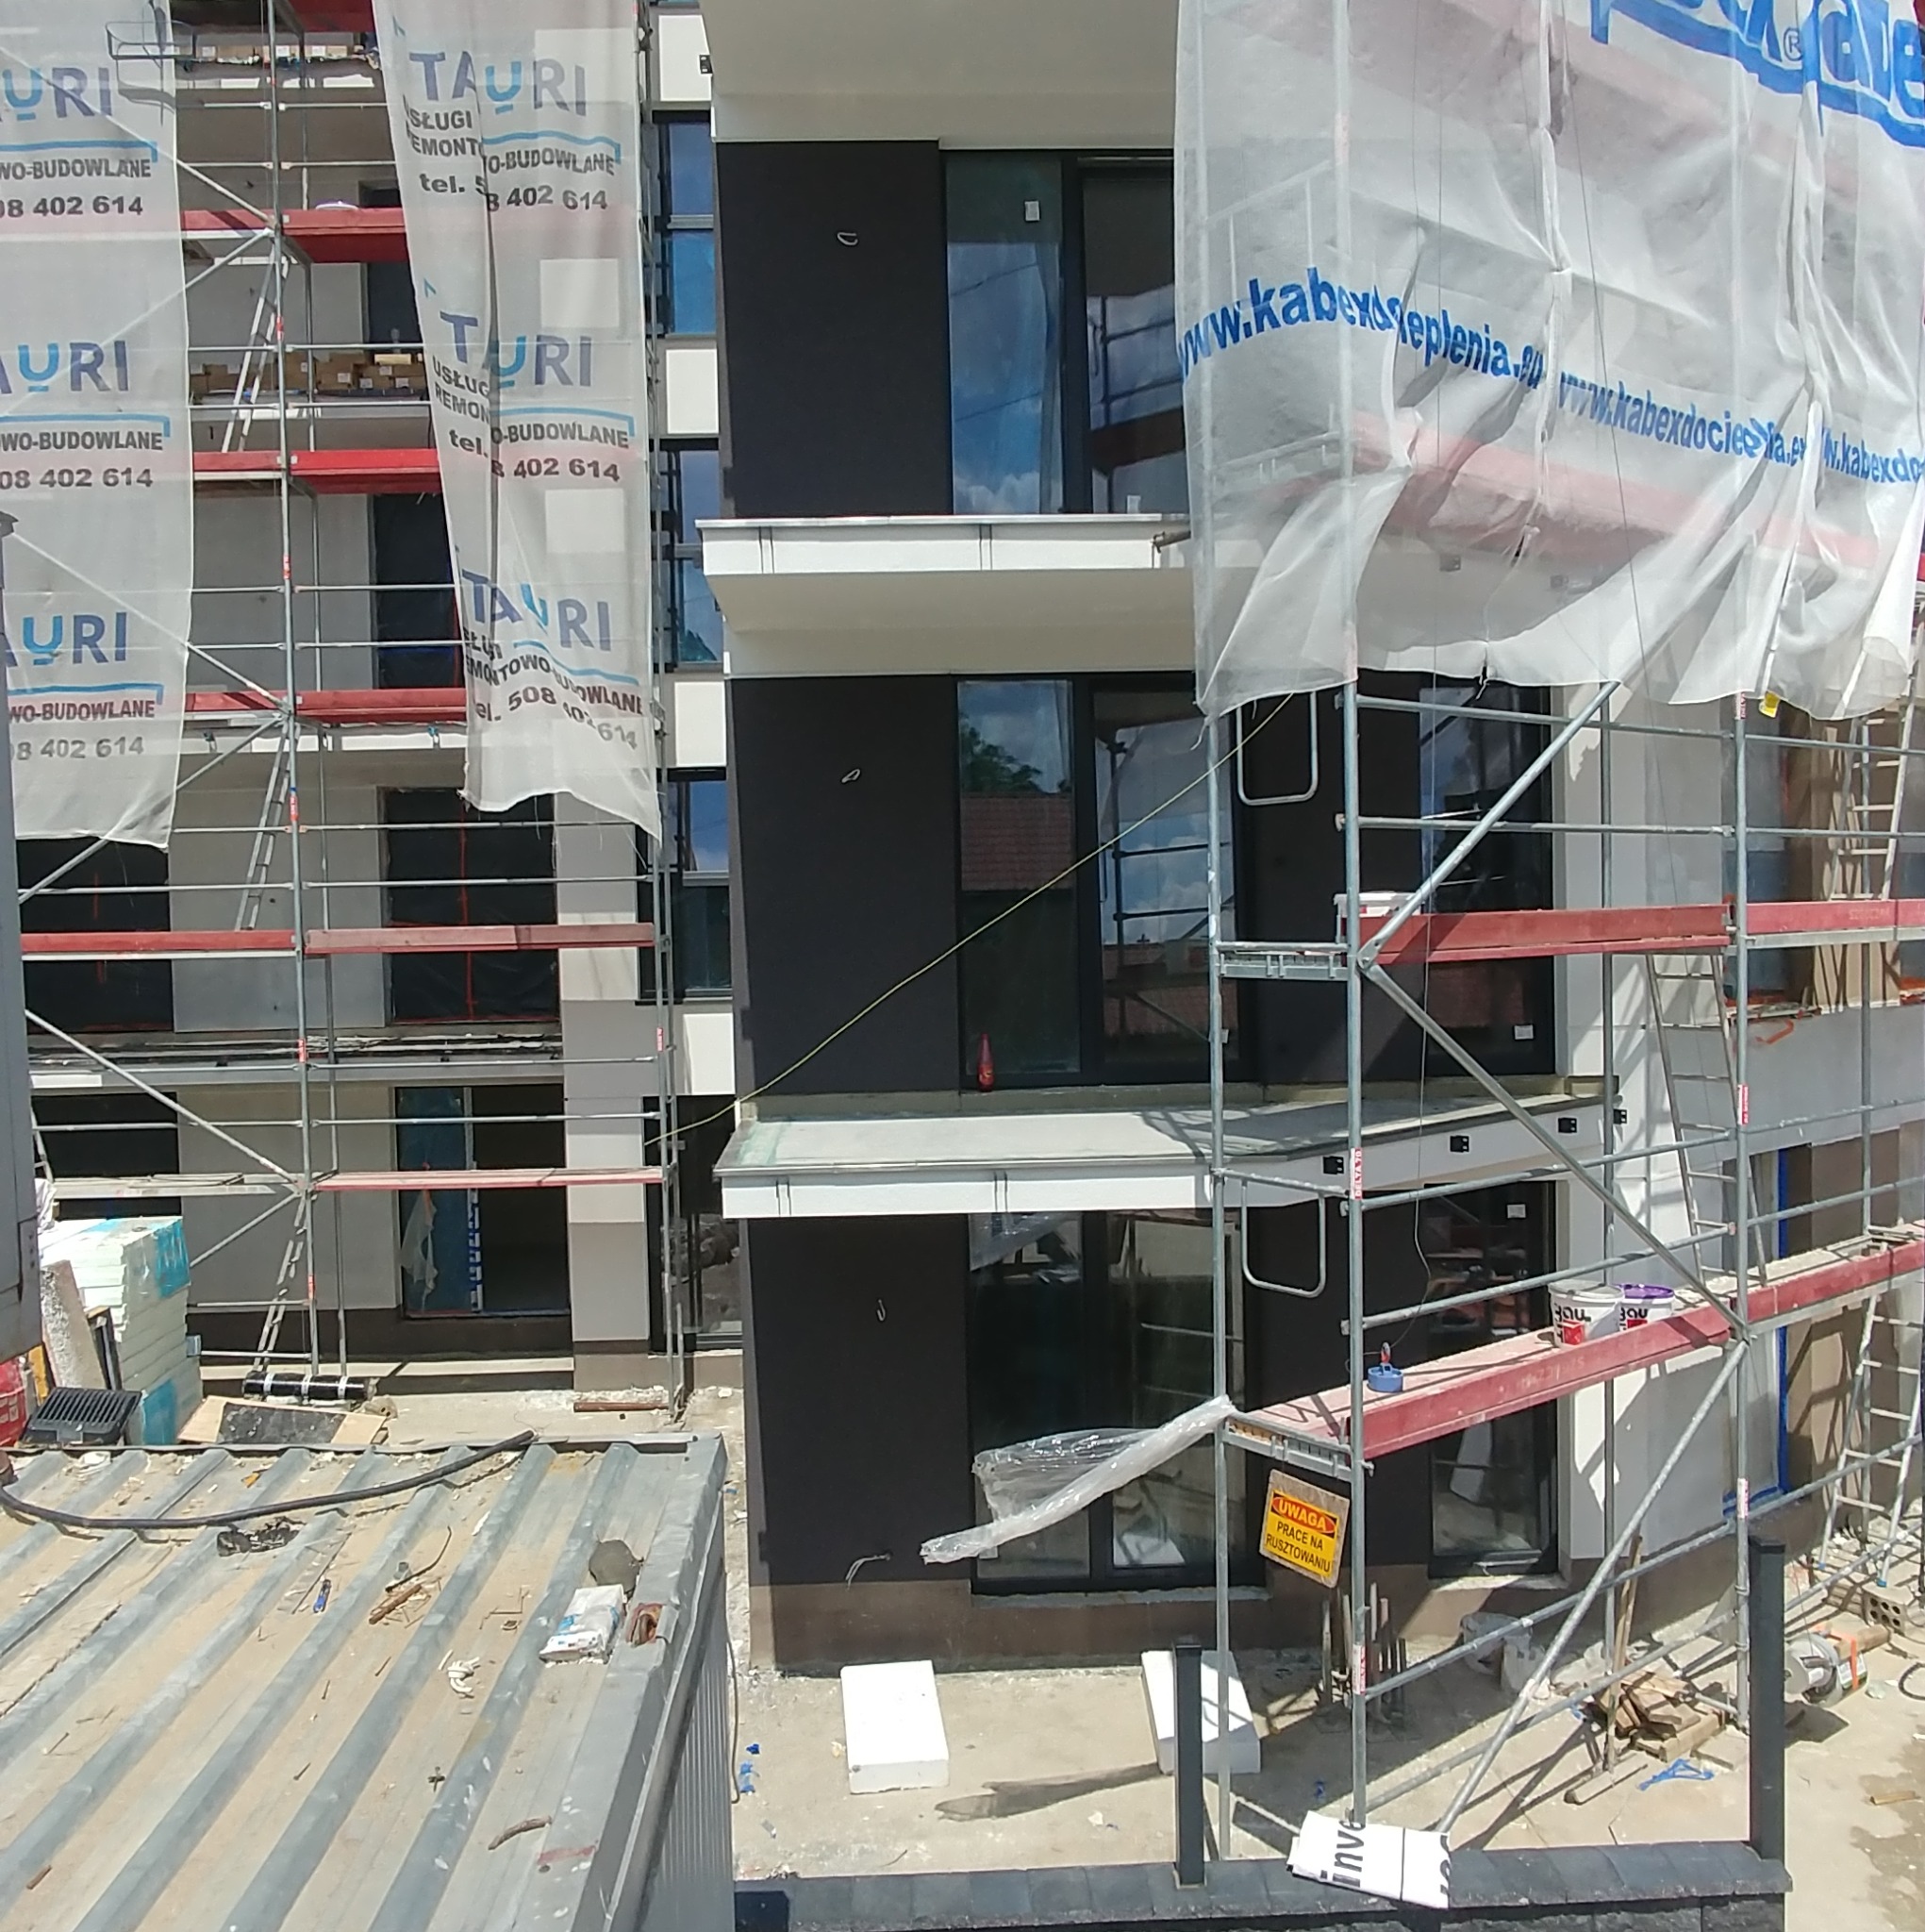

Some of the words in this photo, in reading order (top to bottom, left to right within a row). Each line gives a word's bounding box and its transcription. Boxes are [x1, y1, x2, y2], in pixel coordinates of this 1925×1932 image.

[0, 67, 112, 121] URI
[409, 51, 587, 116] TAURI
[404, 97, 473, 130] SŁUGI
[0, 199, 24, 218] 8
[33, 196, 83, 216] 402
[92, 195, 142, 215] 614
[420, 174, 465, 193] tel.
[506, 186, 553, 207] 402
[562, 191, 608, 210] 614
[440, 311, 591, 390] TURI
[449, 429, 489, 458] tel.
[513, 458, 560, 479] 402
[569, 459, 620, 482] 614
[40, 469, 92, 488] 402
[103, 467, 153, 488] 614
[7, 612, 126, 667] URI
[473, 700, 501, 722] el.
[508, 686, 556, 711] 508
[598, 723, 638, 750] 614
[41, 739, 86, 758] 402
[96, 737, 143, 758] 614
[1278, 1498, 1327, 1531] UWAGA
[1267, 1533, 1331, 1573] RUSZTOWANIU
[1277, 1521, 1308, 1544] PRACE
[1310, 1535, 1323, 1551] NA
